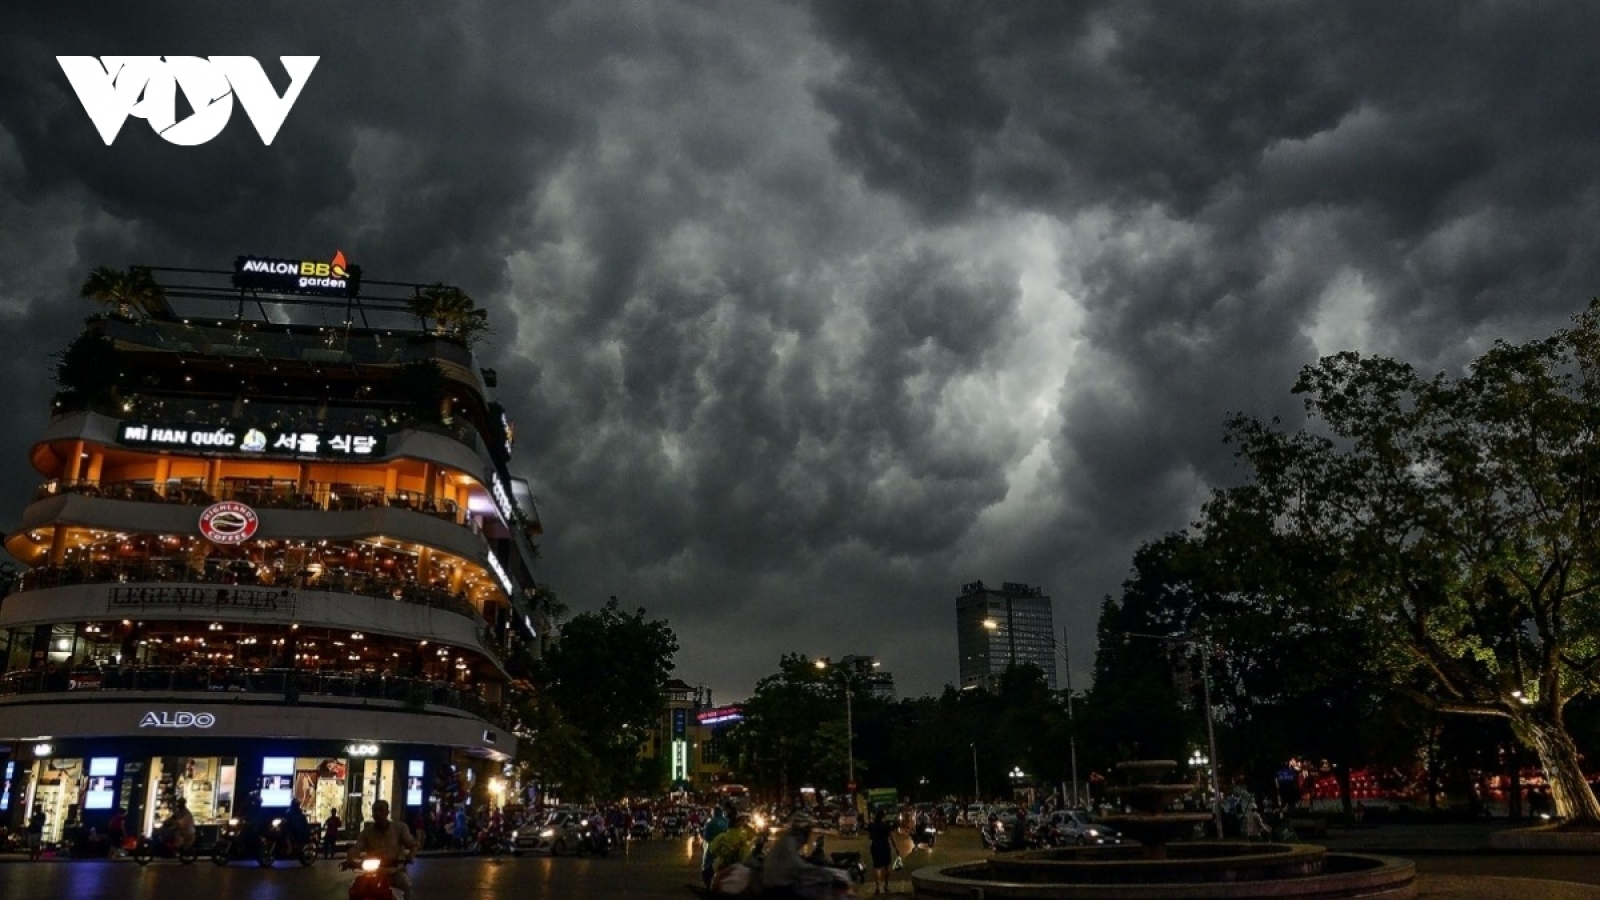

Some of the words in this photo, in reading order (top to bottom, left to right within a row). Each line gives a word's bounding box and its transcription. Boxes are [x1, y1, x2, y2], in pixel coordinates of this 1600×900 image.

[243, 260, 298, 275] AVALON
[299, 276, 346, 289] garden
[124, 425, 147, 441] MÌ
[151, 428, 188, 444] HAN
[273, 433, 321, 453] 서울
[328, 434, 376, 454] 식당
[203, 504, 255, 522] HIGHLANDS
[207, 531, 248, 541] COFFEE
[113, 587, 205, 605] LEGEND
[139, 711, 216, 729] ALDO
[341, 744, 380, 757] ALDO
